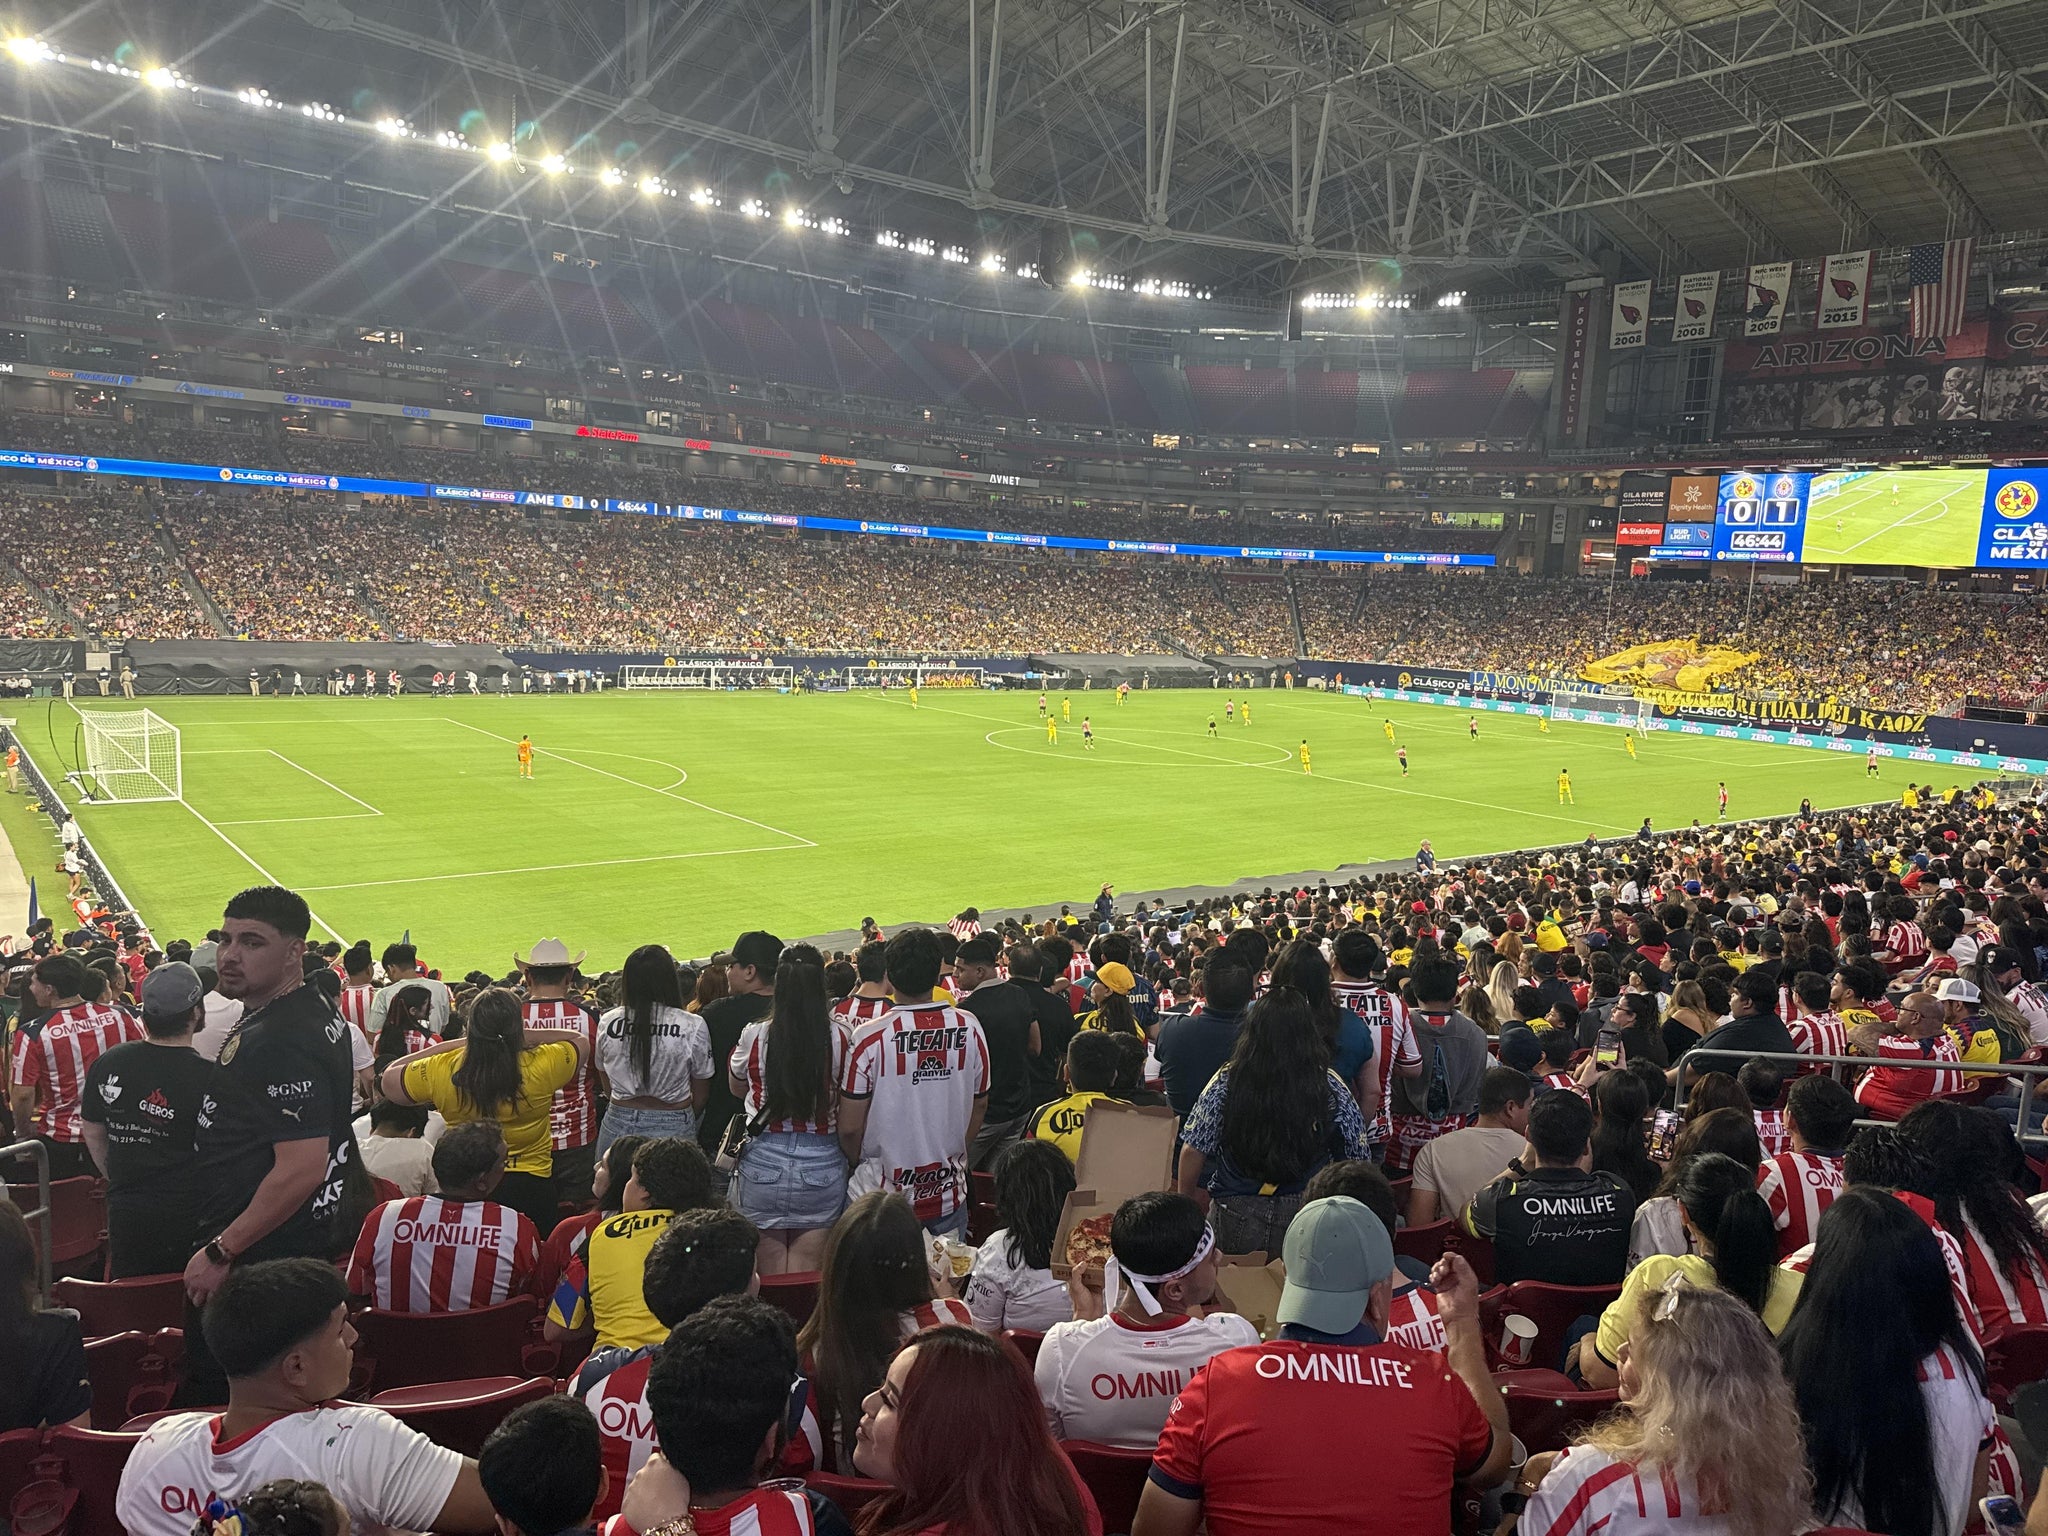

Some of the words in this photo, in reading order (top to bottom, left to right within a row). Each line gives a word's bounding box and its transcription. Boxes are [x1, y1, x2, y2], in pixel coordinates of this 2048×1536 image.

[1830, 258, 1844, 266] NFC
[1845, 256, 1864, 264] WEST
[1755, 267, 1768, 275] NFC
[1829, 263, 1864, 272] DIVISION
[1683, 281, 1714, 289] FOOTBALL
[1684, 275, 1714, 284] NATIONAL
[25, 315, 57, 326] ERNIE
[60, 320, 103, 331] NEVERS
[1823, 311, 1858, 323] 2015
[1750, 320, 1777, 332] 2009
[1677, 328, 1705, 338] 2008
[1614, 335, 1642, 345] 2008
[1571, 307, 1584, 391] FOOTBALL
[1751, 333, 1946, 369] ARIZONA
[48, 369, 73, 379] desert
[406, 364, 448, 374] DIERDORF
[303, 397, 351, 409] HYUNDAI
[650, 396, 672, 405] LARRY
[675, 399, 701, 408] WILSON
[402, 406, 431, 417] COX
[37, 457, 84, 467] MÉXICO
[235, 472, 274, 482] CLÁSICO
[289, 476, 327, 486] MÉXICO
[989, 474, 1020, 486] AVNET
[526, 494, 554, 506] AME
[1623, 491, 1640, 499] GILA
[590, 499, 599, 509] 0
[617, 501, 648, 513] 46:44
[665, 506, 671, 514] 1
[1670, 504, 1692, 512] Dignity
[1733, 502, 1751, 518] 0
[1776, 502, 1788, 518] 1
[702, 508, 722, 520] CHI
[1734, 535, 1782, 548] 46:44
[678, 659, 714, 667] CLÁSICO
[727, 660, 762, 668] MÉXICO
[1413, 676, 1455, 688] CLÁSICO
[1457, 681, 1471, 690] DE
[1472, 672, 1489, 686] LA
[1736, 698, 1814, 719] RITUAL
[1818, 702, 1856, 725] DEL
[1860, 710, 1928, 733] KAOZ
[1681, 724, 1703, 734] ZERO
[1715, 728, 1738, 738] ZERO
[1751, 733, 1774, 742] ZERO
[1788, 737, 1812, 747] ZERO
[1826, 741, 1852, 752] ZERO
[1908, 751, 1936, 762] ZERO
[1951, 756, 1981, 766] ZERO
[50, 1014, 114, 1038] OMNILIFE
[891, 1027, 969, 1054] TECATE
[912, 1069, 952, 1085] granvita
[278, 1080, 312, 1096] GNP
[1523, 1194, 1616, 1215] OMNILIFE
[394, 1218, 502, 1248] OMNILIFE
[1255, 1353, 1413, 1388] OMNILIFE
